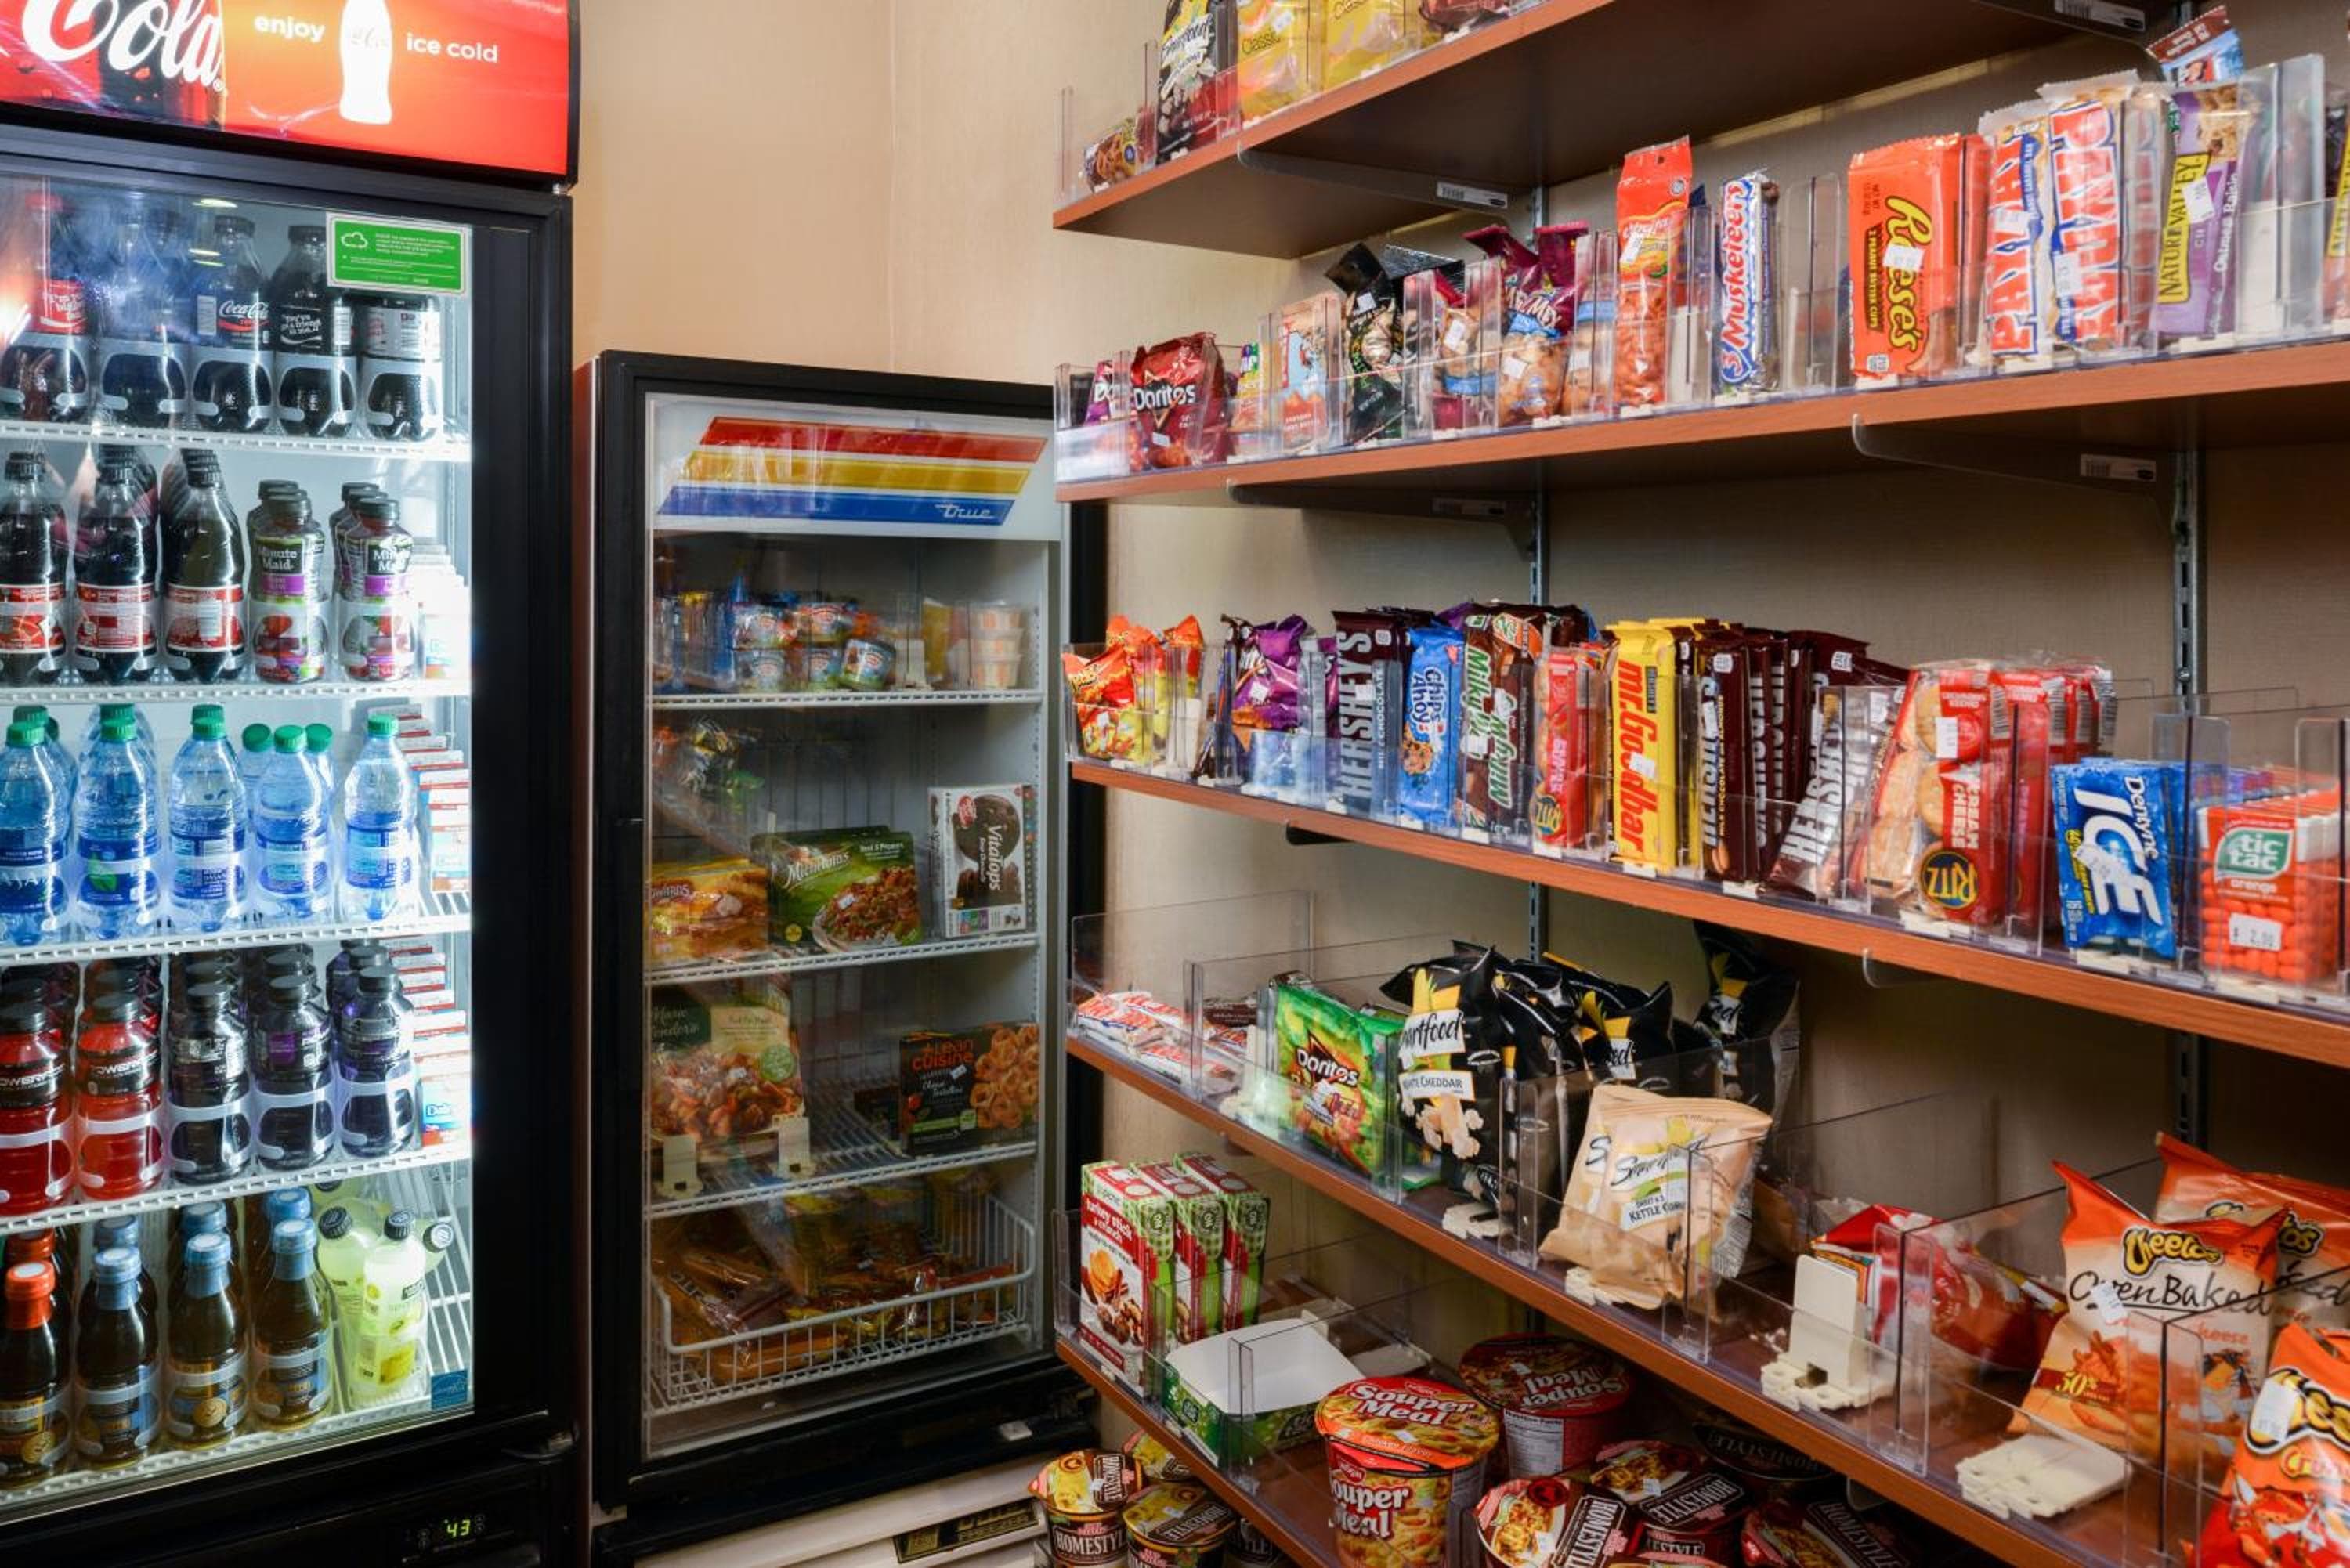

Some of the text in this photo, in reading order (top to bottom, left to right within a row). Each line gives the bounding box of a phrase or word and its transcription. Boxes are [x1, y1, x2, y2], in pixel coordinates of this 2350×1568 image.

[254, 16, 326, 42] enjoy
[405, 32, 499, 63] ice cold
[1868, 237, 1878, 271] PEANUT
[2159, 229, 2186, 298] NATURE
[1720, 183, 1748, 378] Musketeers 3
[1885, 195, 1933, 352] Reese's
[1868, 306, 1878, 328] CUPS
[1133, 382, 1197, 410] Doritos
[1424, 667, 1444, 722] Chips
[1337, 630, 1373, 800] HERSHEY'S
[1951, 783, 1967, 849] CHEESE
[2124, 775, 2159, 861] Dentyne
[986, 824, 1003, 892] VitaTops
[2073, 787, 2164, 927] ICE
[2229, 850, 2277, 871] tac
[2241, 833, 2283, 856] tic
[1926, 861, 1978, 902] RITZ
[2231, 879, 2278, 895] orange
[911, 1050, 974, 1071] cuisine
[1296, 1046, 1360, 1087] Doritos
[1420, 1075, 1464, 1090] CHEDDAR
[1629, 1205, 1661, 1223] KETTLE
[2124, 1227, 2223, 1277] Cheetos
[2163, 1270, 2272, 1317] Baked
[1520, 1376, 1625, 1408] Souper
[1524, 1368, 1600, 1394] Meal
[1349, 1383, 1478, 1414] Souper
[1357, 1398, 1453, 1426] Meal
[1649, 1475, 1739, 1525] HOMESTYLE
[446, 1519, 471, 1539] 43
[1056, 1530, 1125, 1556] HOMESTYL
